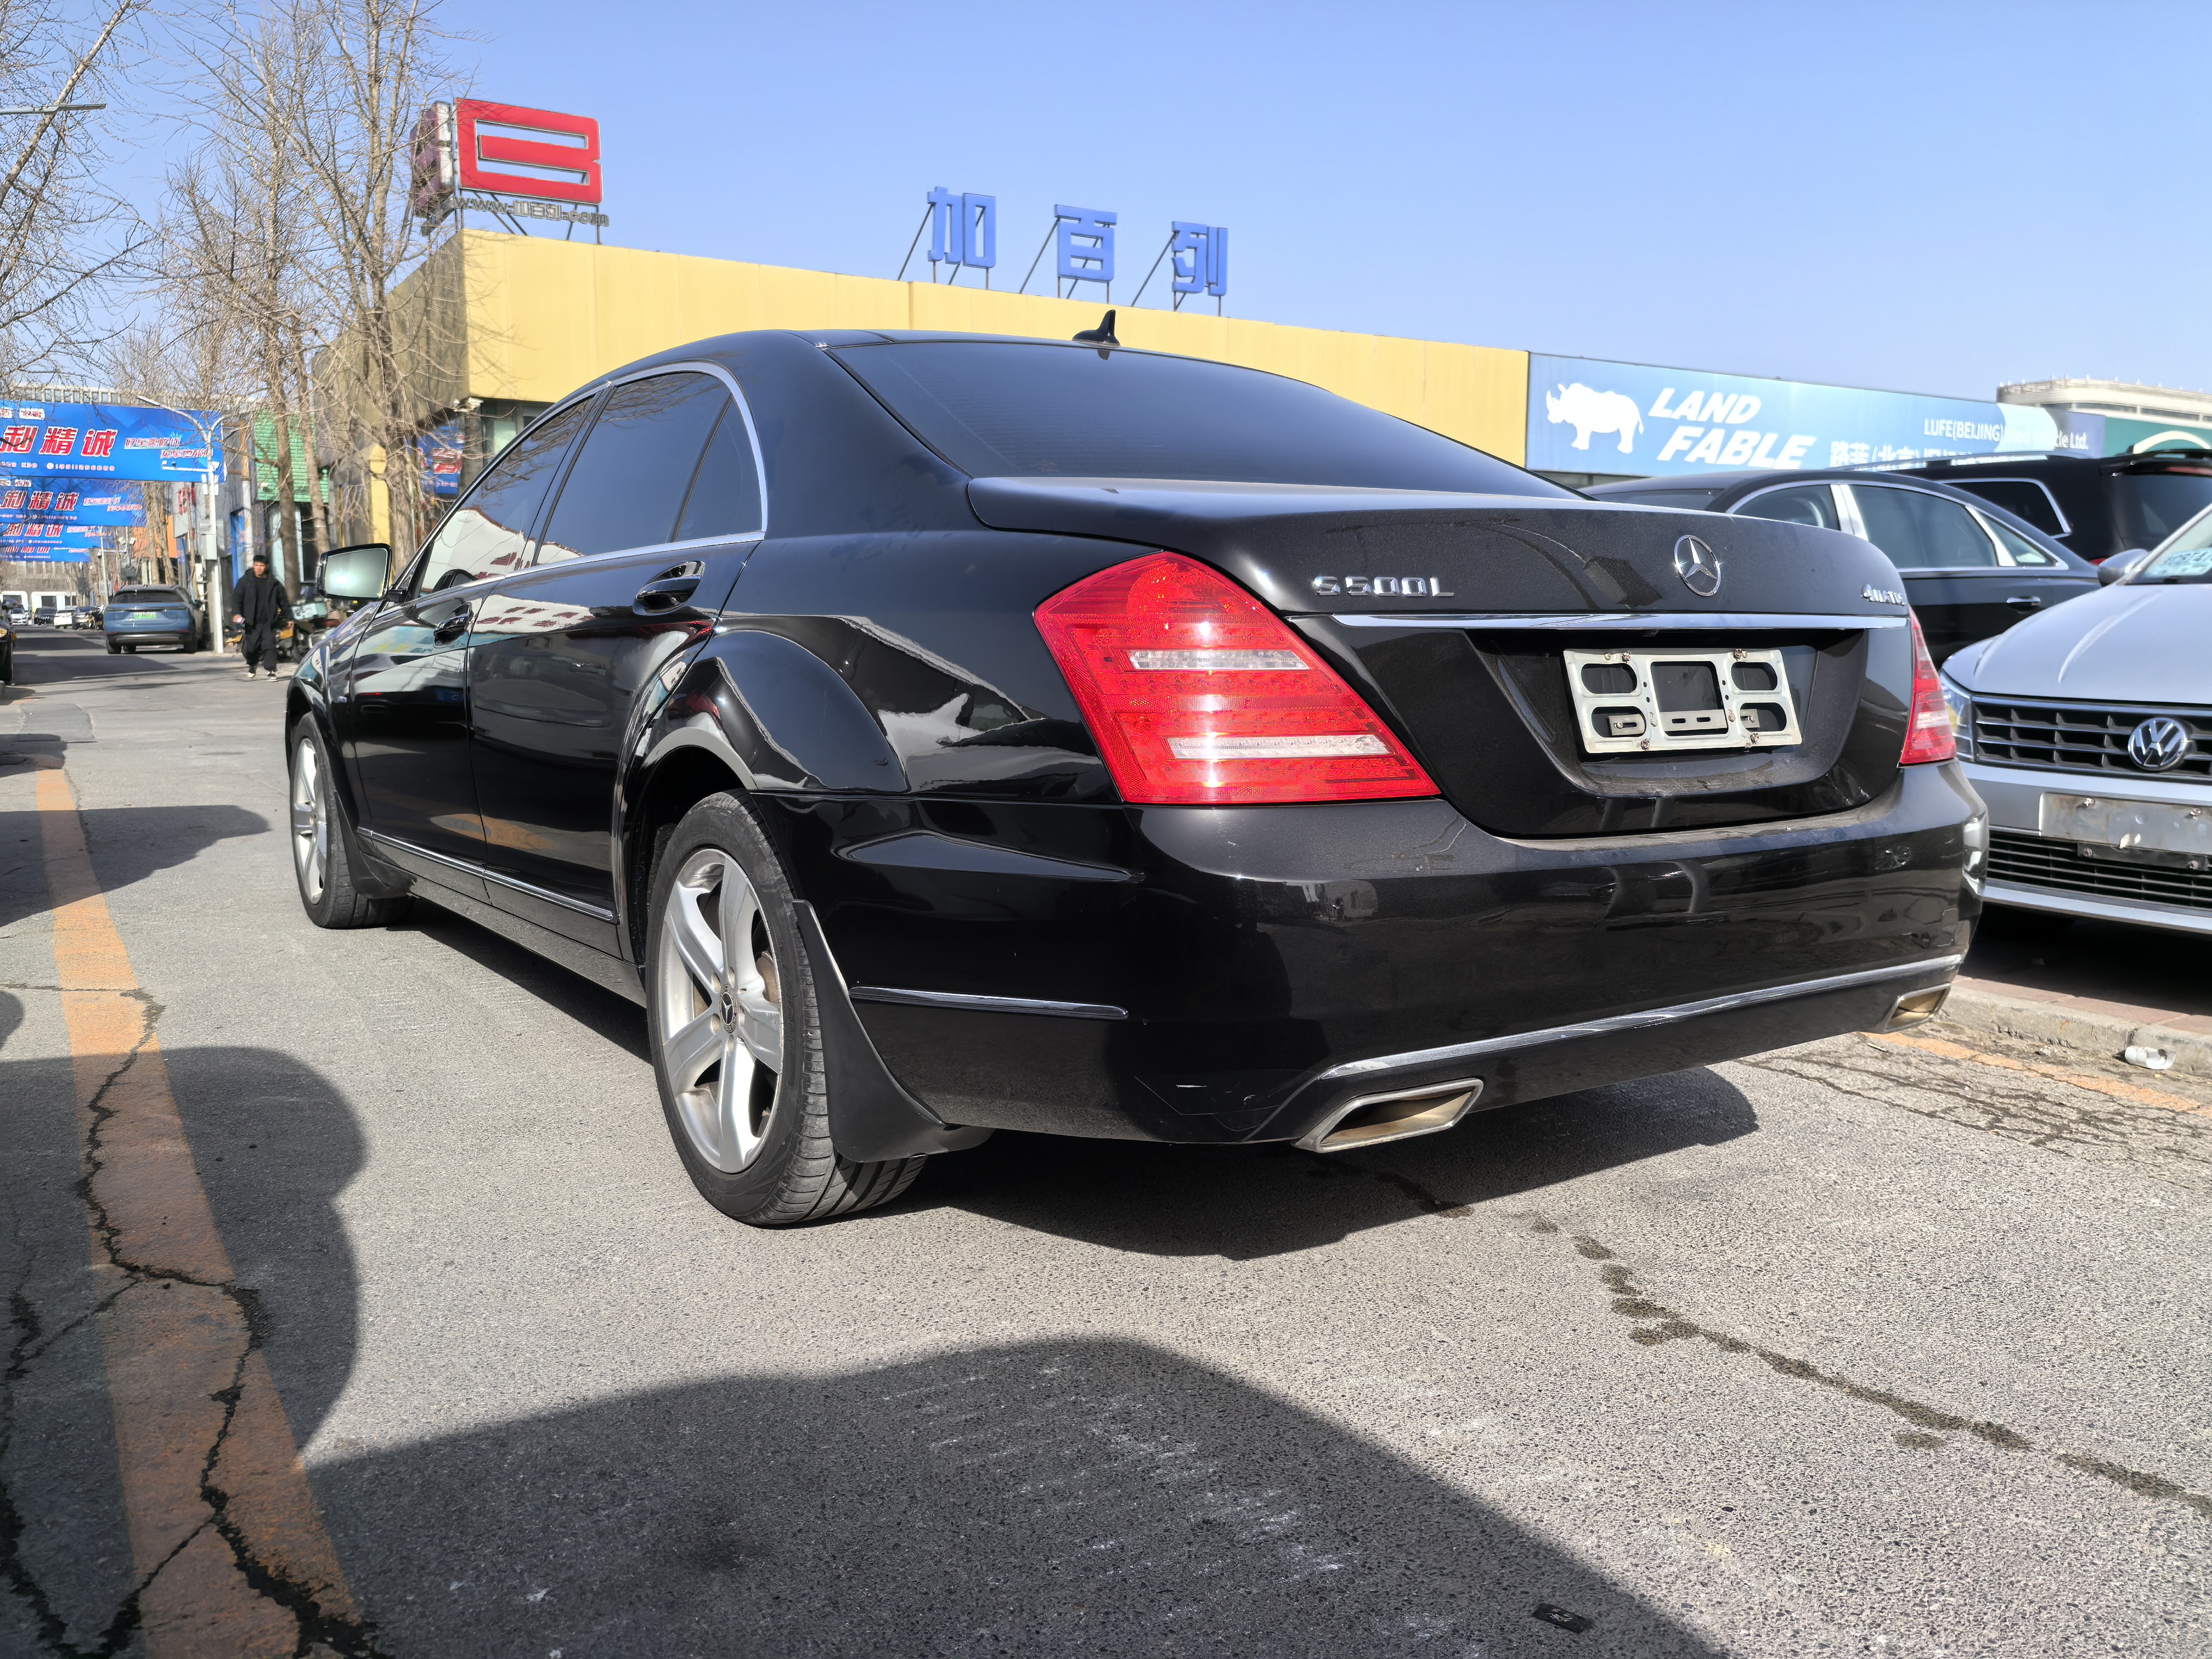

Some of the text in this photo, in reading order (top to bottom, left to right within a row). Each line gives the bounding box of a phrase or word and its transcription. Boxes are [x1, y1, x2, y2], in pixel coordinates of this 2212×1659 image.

[927, 186, 1228, 296] 加百列
[1648, 387, 1762, 424] LAND
[1656, 426, 1817, 469] FABLE
[1313, 576, 1455, 597] S500L
